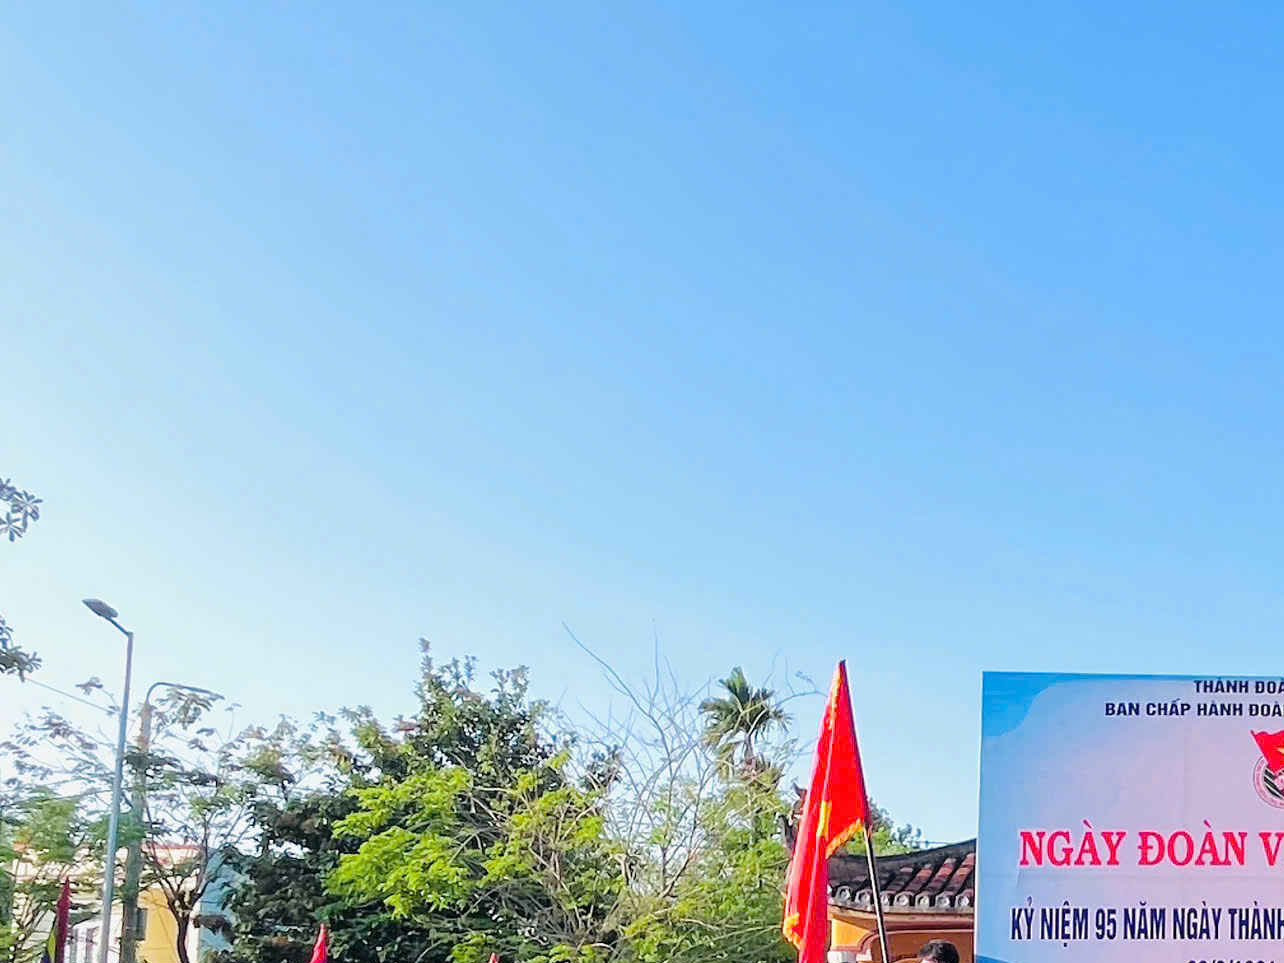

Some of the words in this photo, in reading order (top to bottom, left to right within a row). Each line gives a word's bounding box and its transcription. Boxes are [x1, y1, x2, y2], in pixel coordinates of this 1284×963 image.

[1194, 678, 1249, 694] THÀNH
[1105, 702, 1140, 716] BAN
[1146, 698, 1191, 716] CHẤP
[1197, 700, 1243, 717] HÀNH
[1020, 819, 1126, 866] NGÀY
[1138, 819, 1247, 867] ĐOÀN
[1011, 896, 1035, 940] KỶ
[1040, 901, 1089, 948] NIỆM
[1095, 908, 1117, 940] 95
[1123, 901, 1166, 940] NĂM
[1173, 901, 1222, 940] NGÀY
